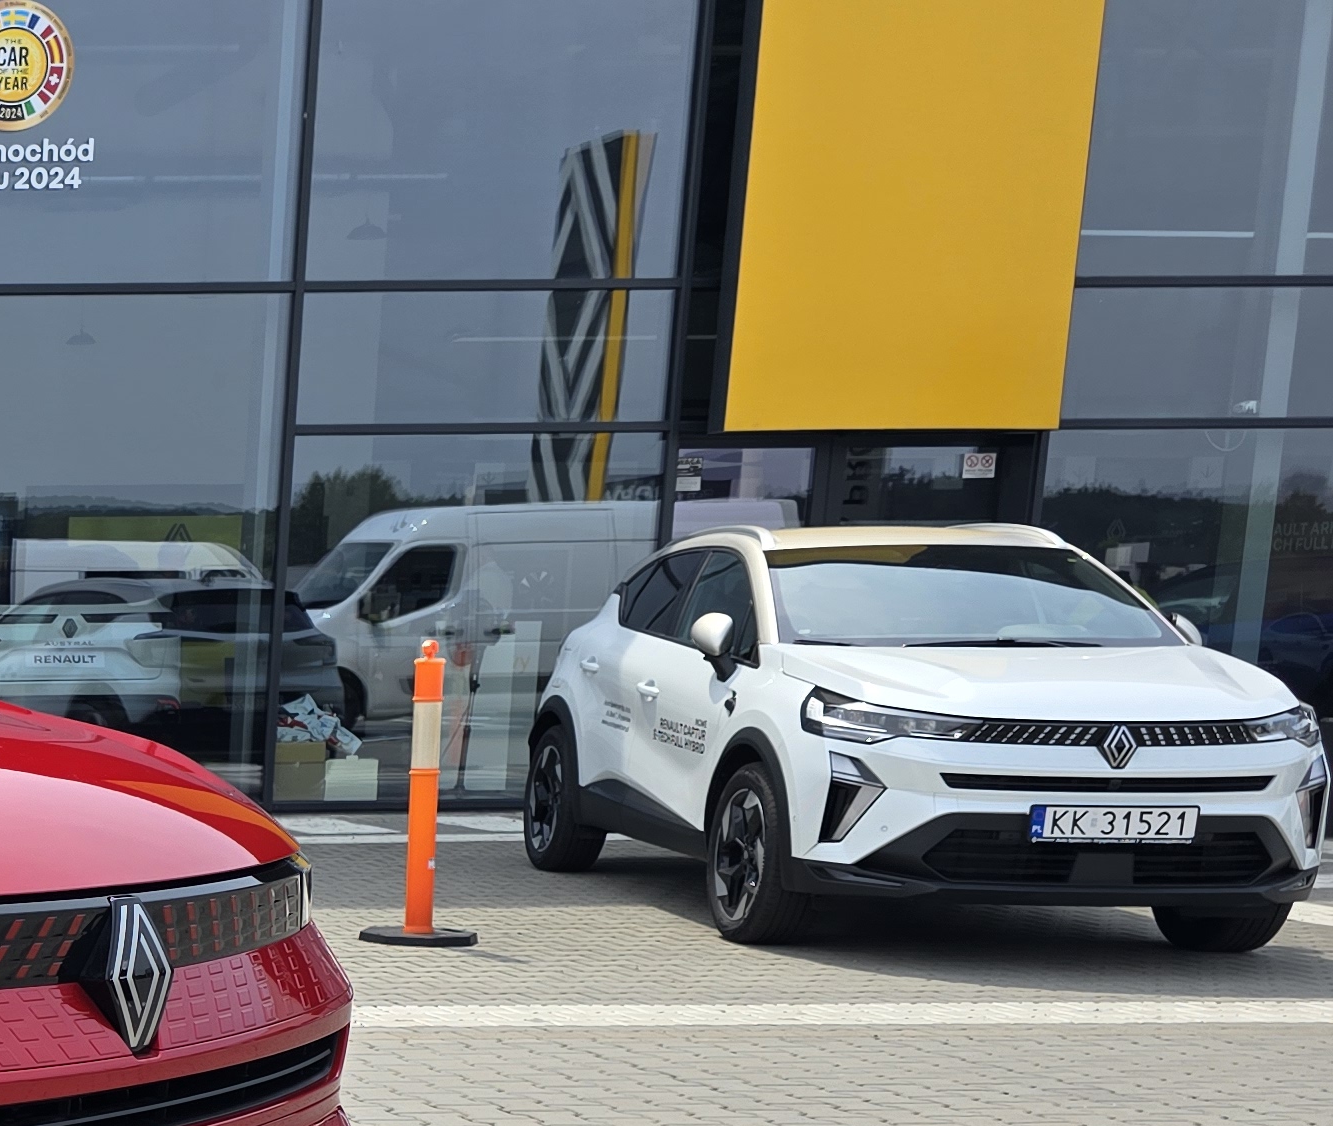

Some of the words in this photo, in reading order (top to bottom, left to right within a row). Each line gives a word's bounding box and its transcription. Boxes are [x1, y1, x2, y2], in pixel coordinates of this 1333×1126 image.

[0, 106, 23, 119] 2024
[14, 167, 82, 190] 2024
[33, 654, 97, 664] RENAULT
[659, 717, 683, 734] RENAULT
[1050, 810, 1089, 836] KK
[1100, 810, 1187, 836] 31521
